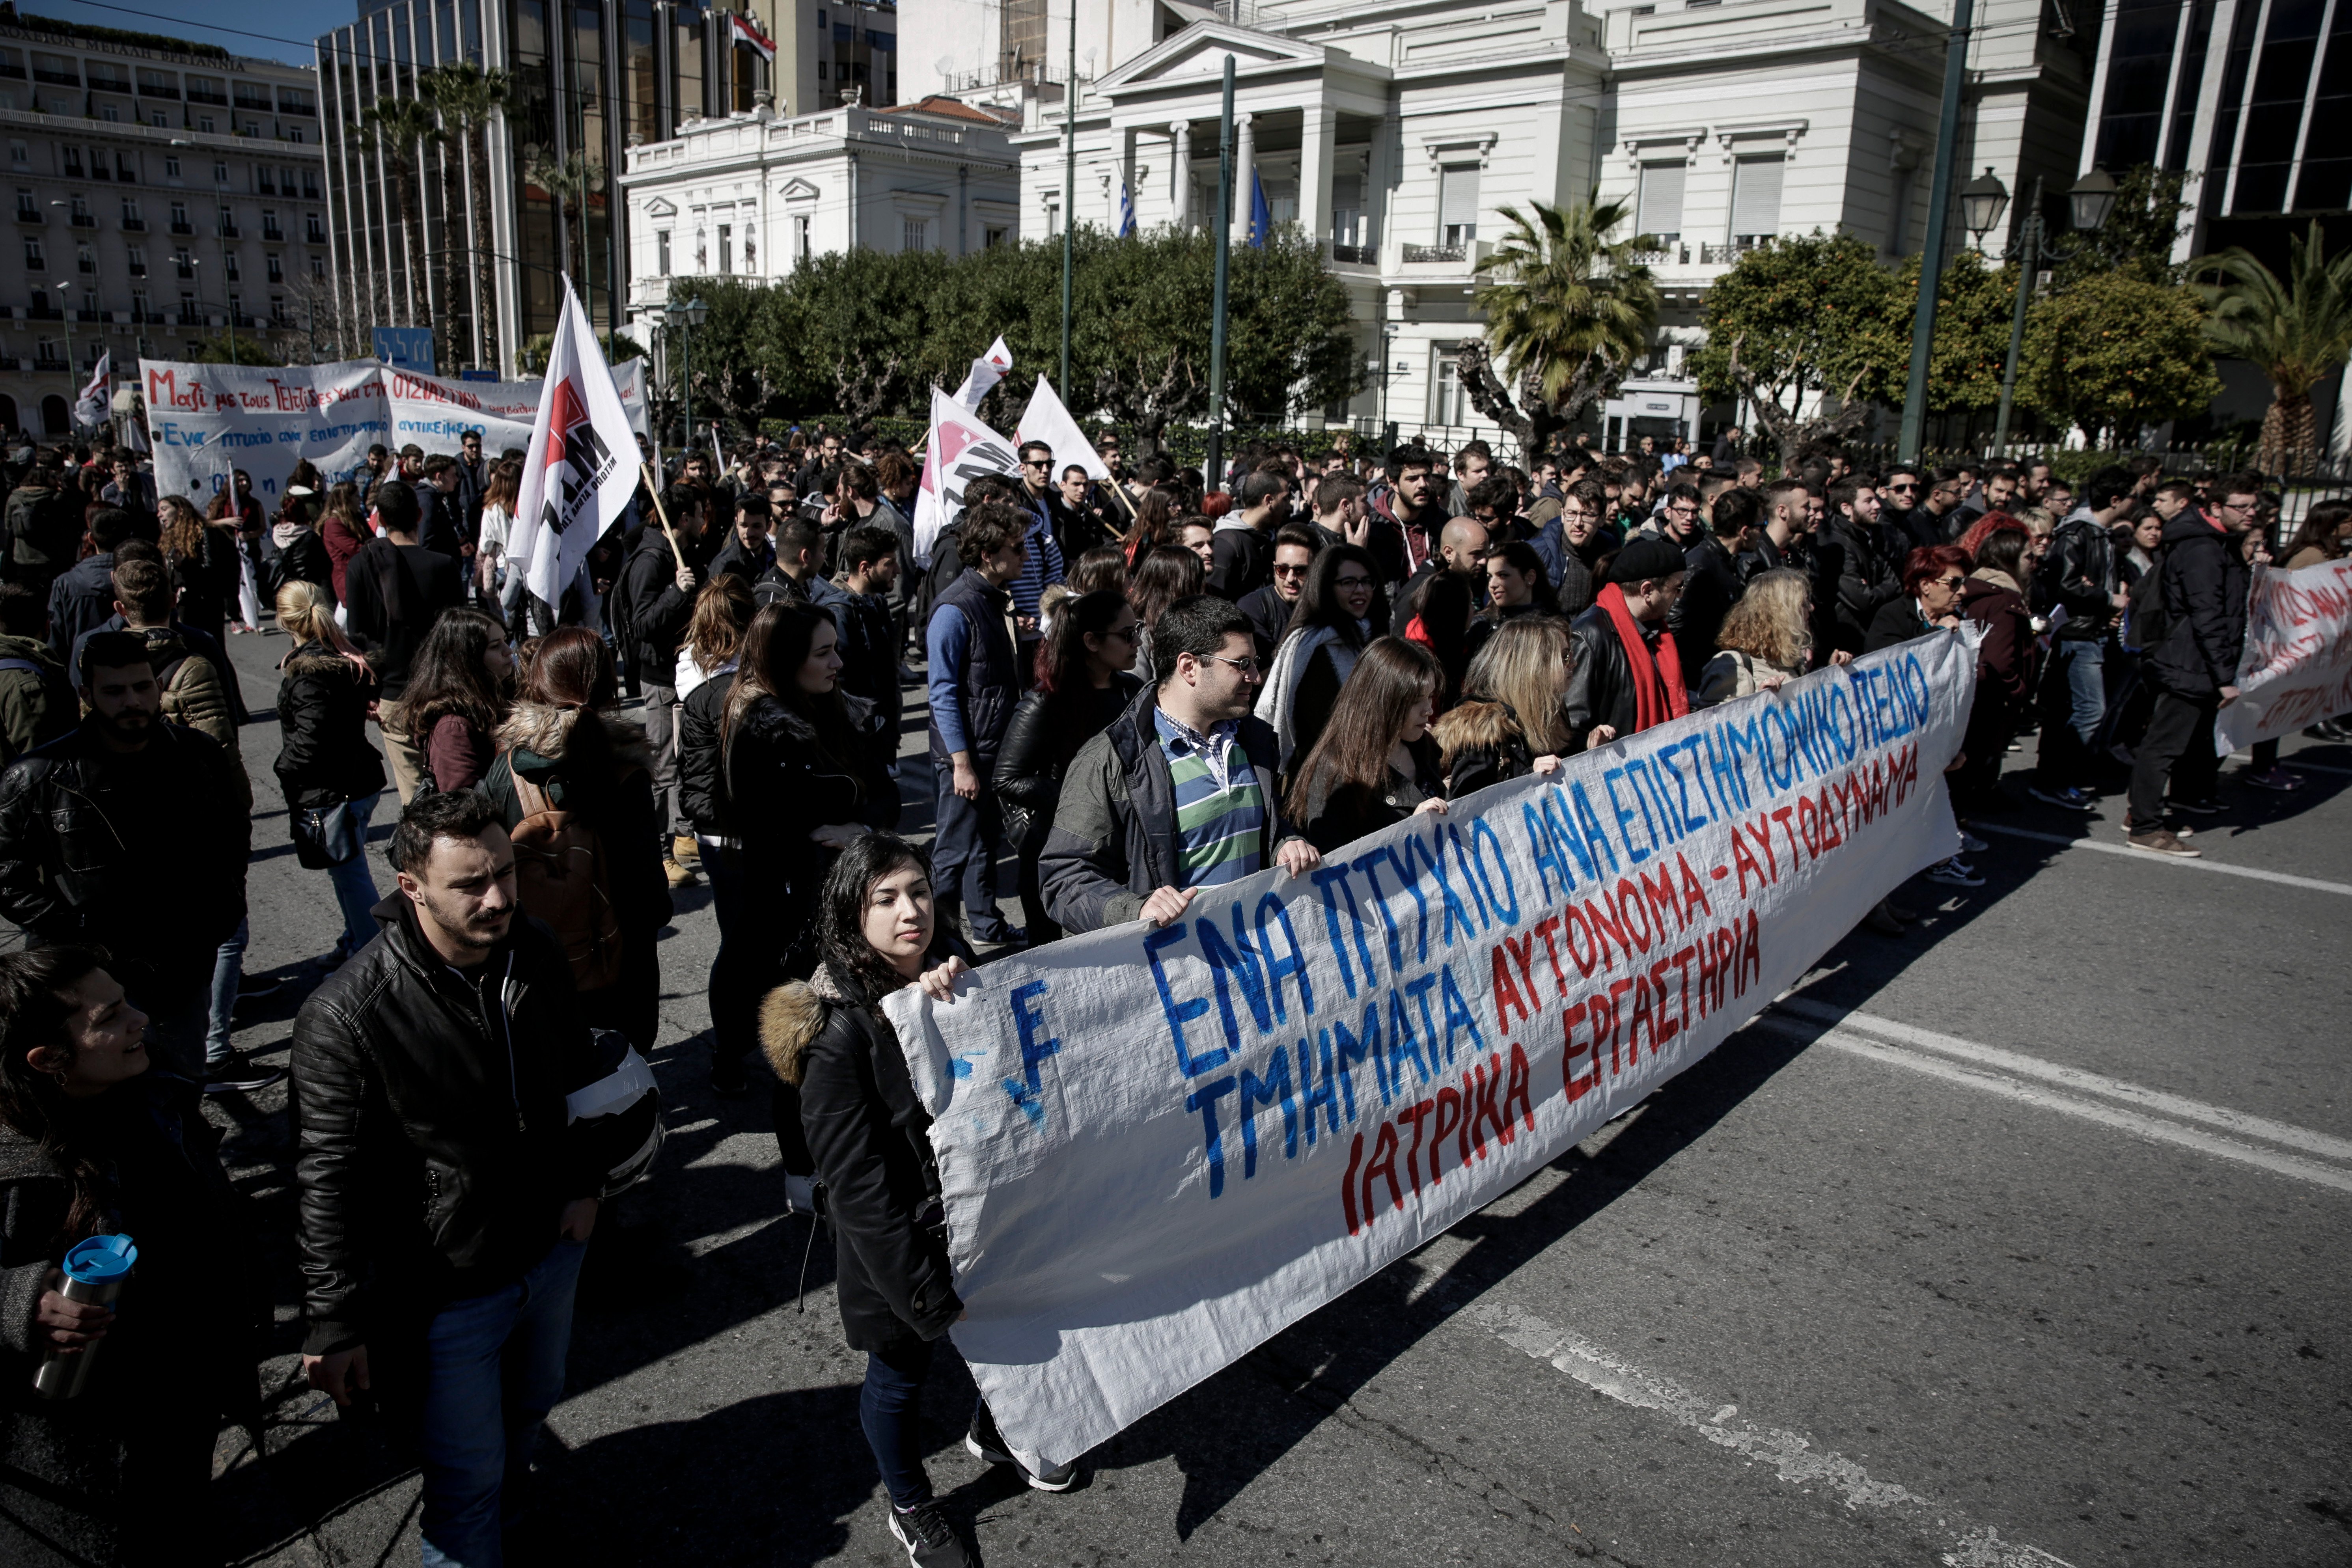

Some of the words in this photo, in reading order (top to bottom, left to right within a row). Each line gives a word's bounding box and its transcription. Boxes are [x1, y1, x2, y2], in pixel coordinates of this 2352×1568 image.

[161, 50, 246, 72] ΒΡΕΤΑΝΝΙΑ
[1143, 892, 1314, 1079] ΕΝΑ
[1311, 815, 1521, 999] ΠΤΥΧΙΟ
[1522, 780, 1620, 906] ΑΝΑ
[1186, 964, 1483, 1200] ΤΜΗΜΑΤΑ
[1342, 1042, 1535, 1236] ΙΑΤΡΙΚΑ
[1562, 908, 1760, 1104] ΕΡΓΑΣΤΗΡΙΑ
